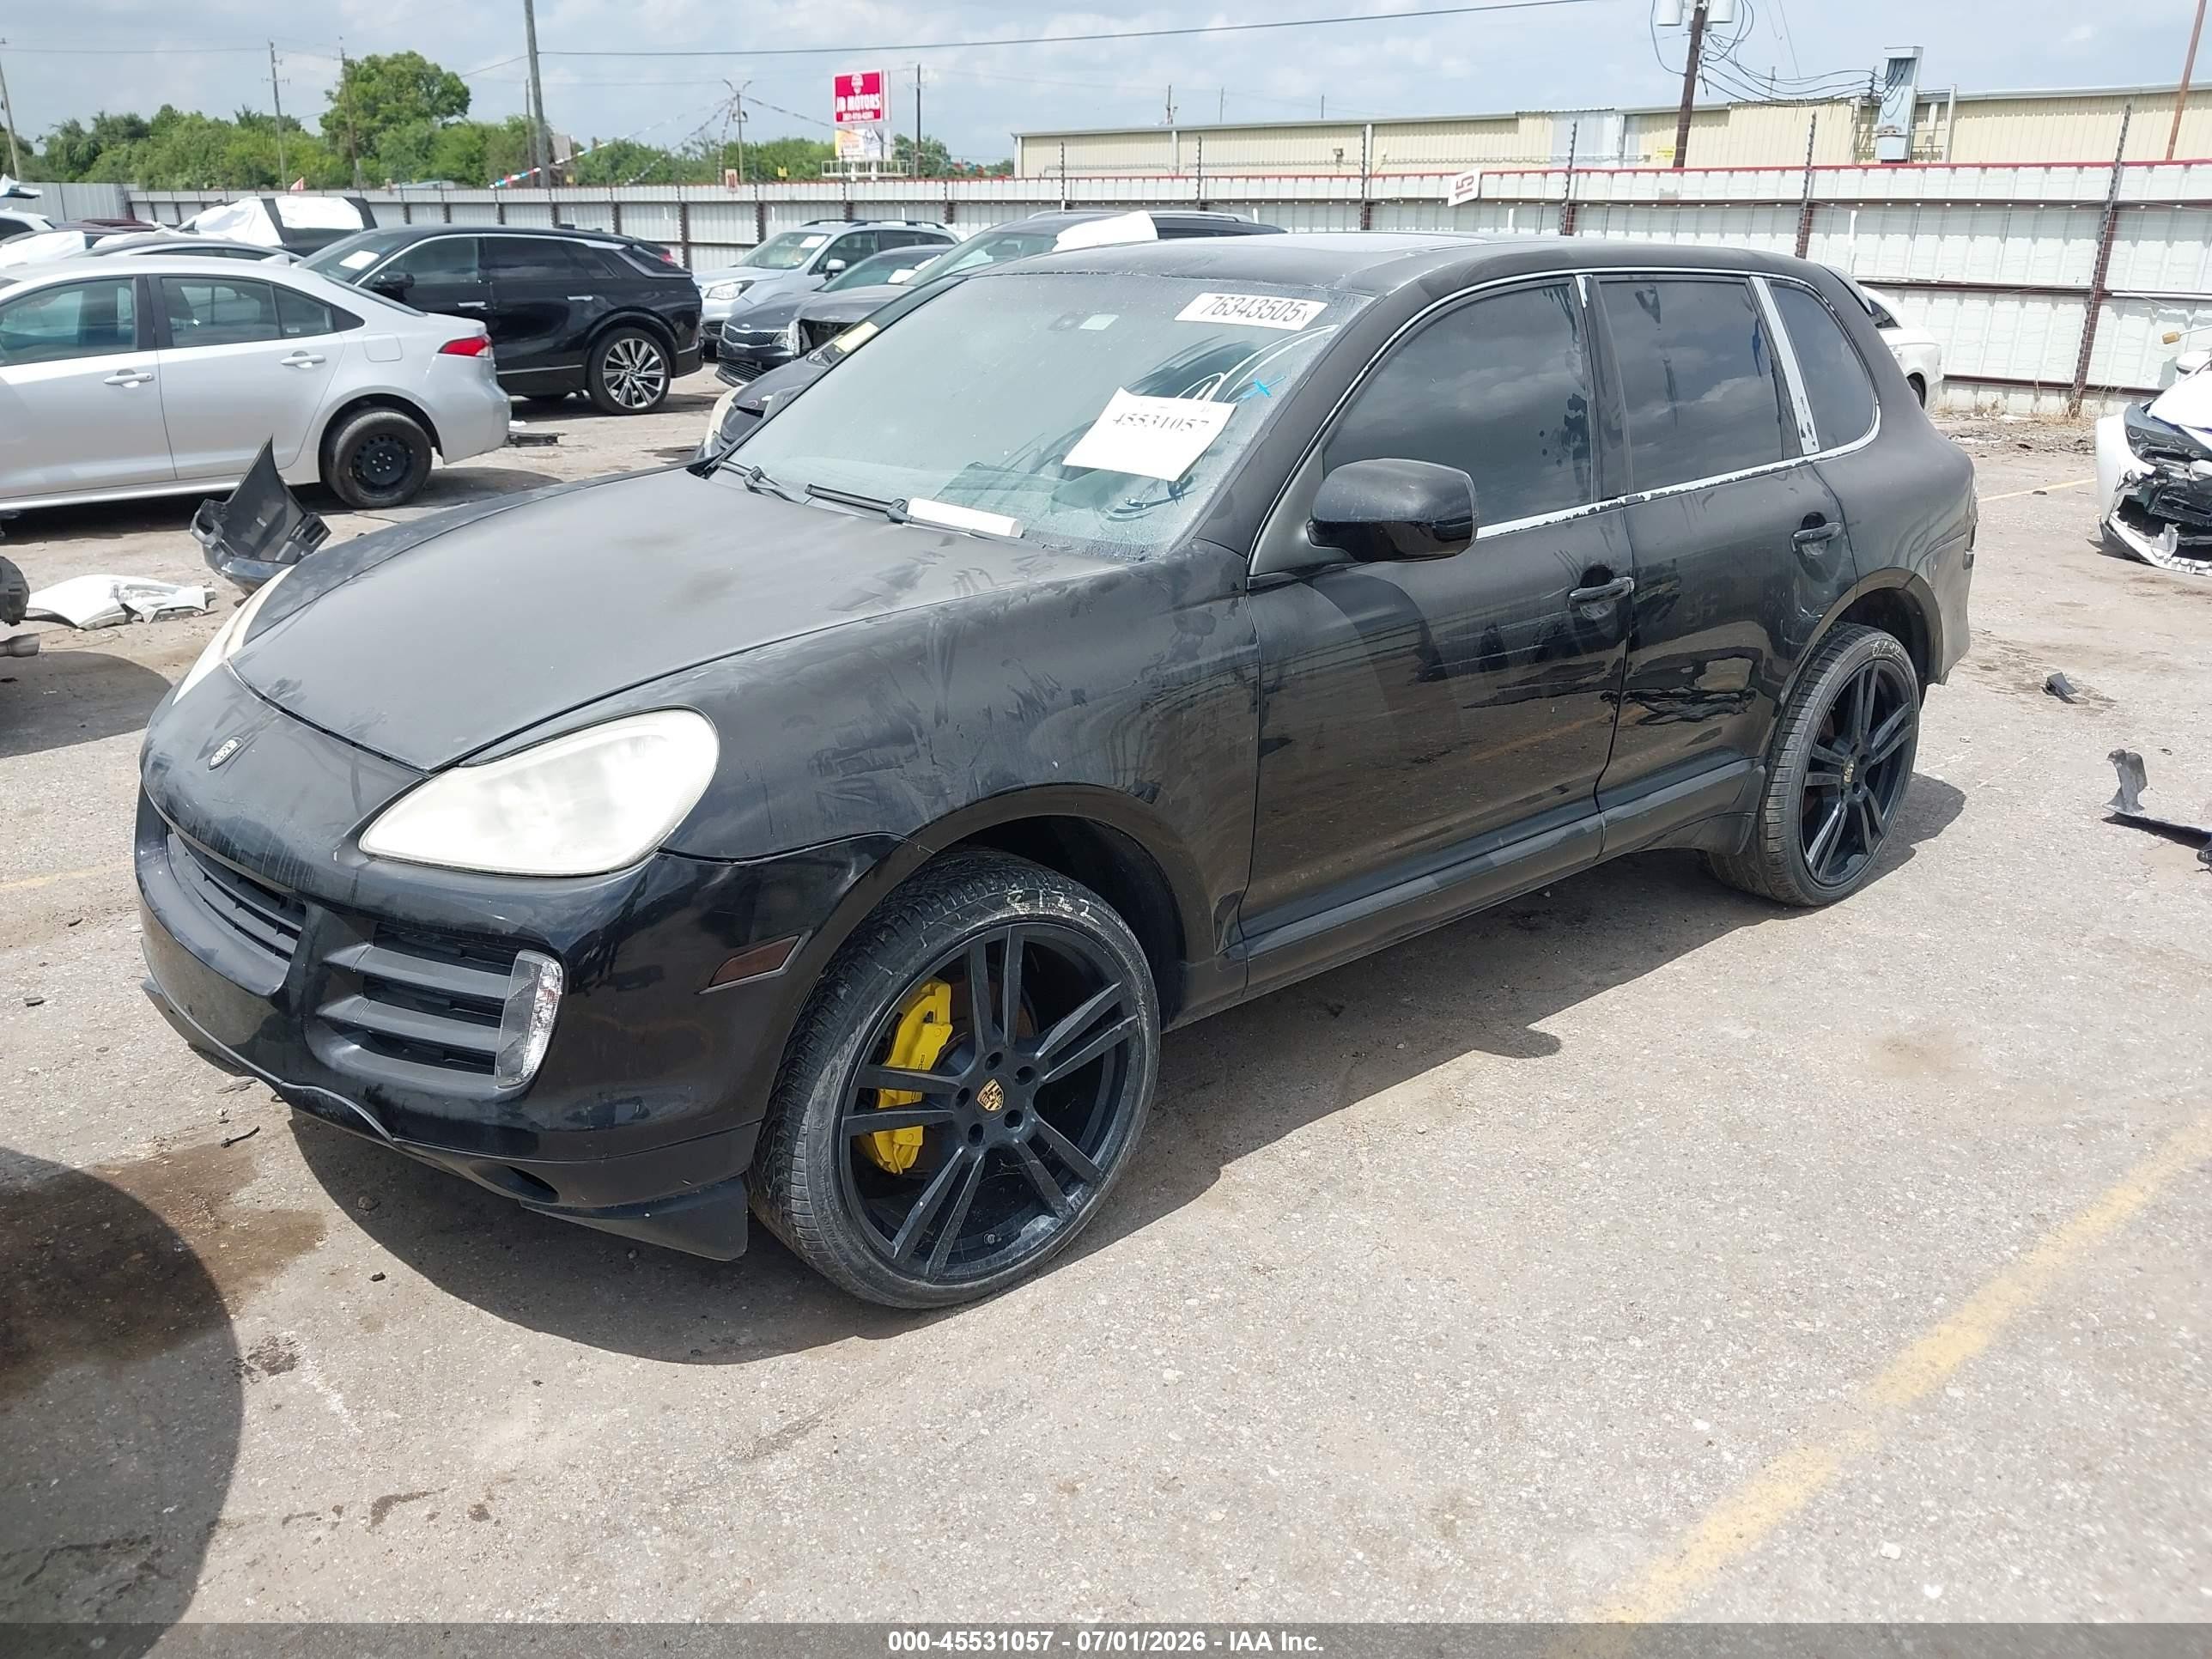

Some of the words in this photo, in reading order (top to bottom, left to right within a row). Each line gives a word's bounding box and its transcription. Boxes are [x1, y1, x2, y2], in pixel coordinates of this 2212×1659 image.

[847, 93, 880, 111] MOTORS
[1455, 174, 1474, 200] 15
[1199, 295, 1309, 323] 76343505
[1112, 413, 1210, 432] 45531057
